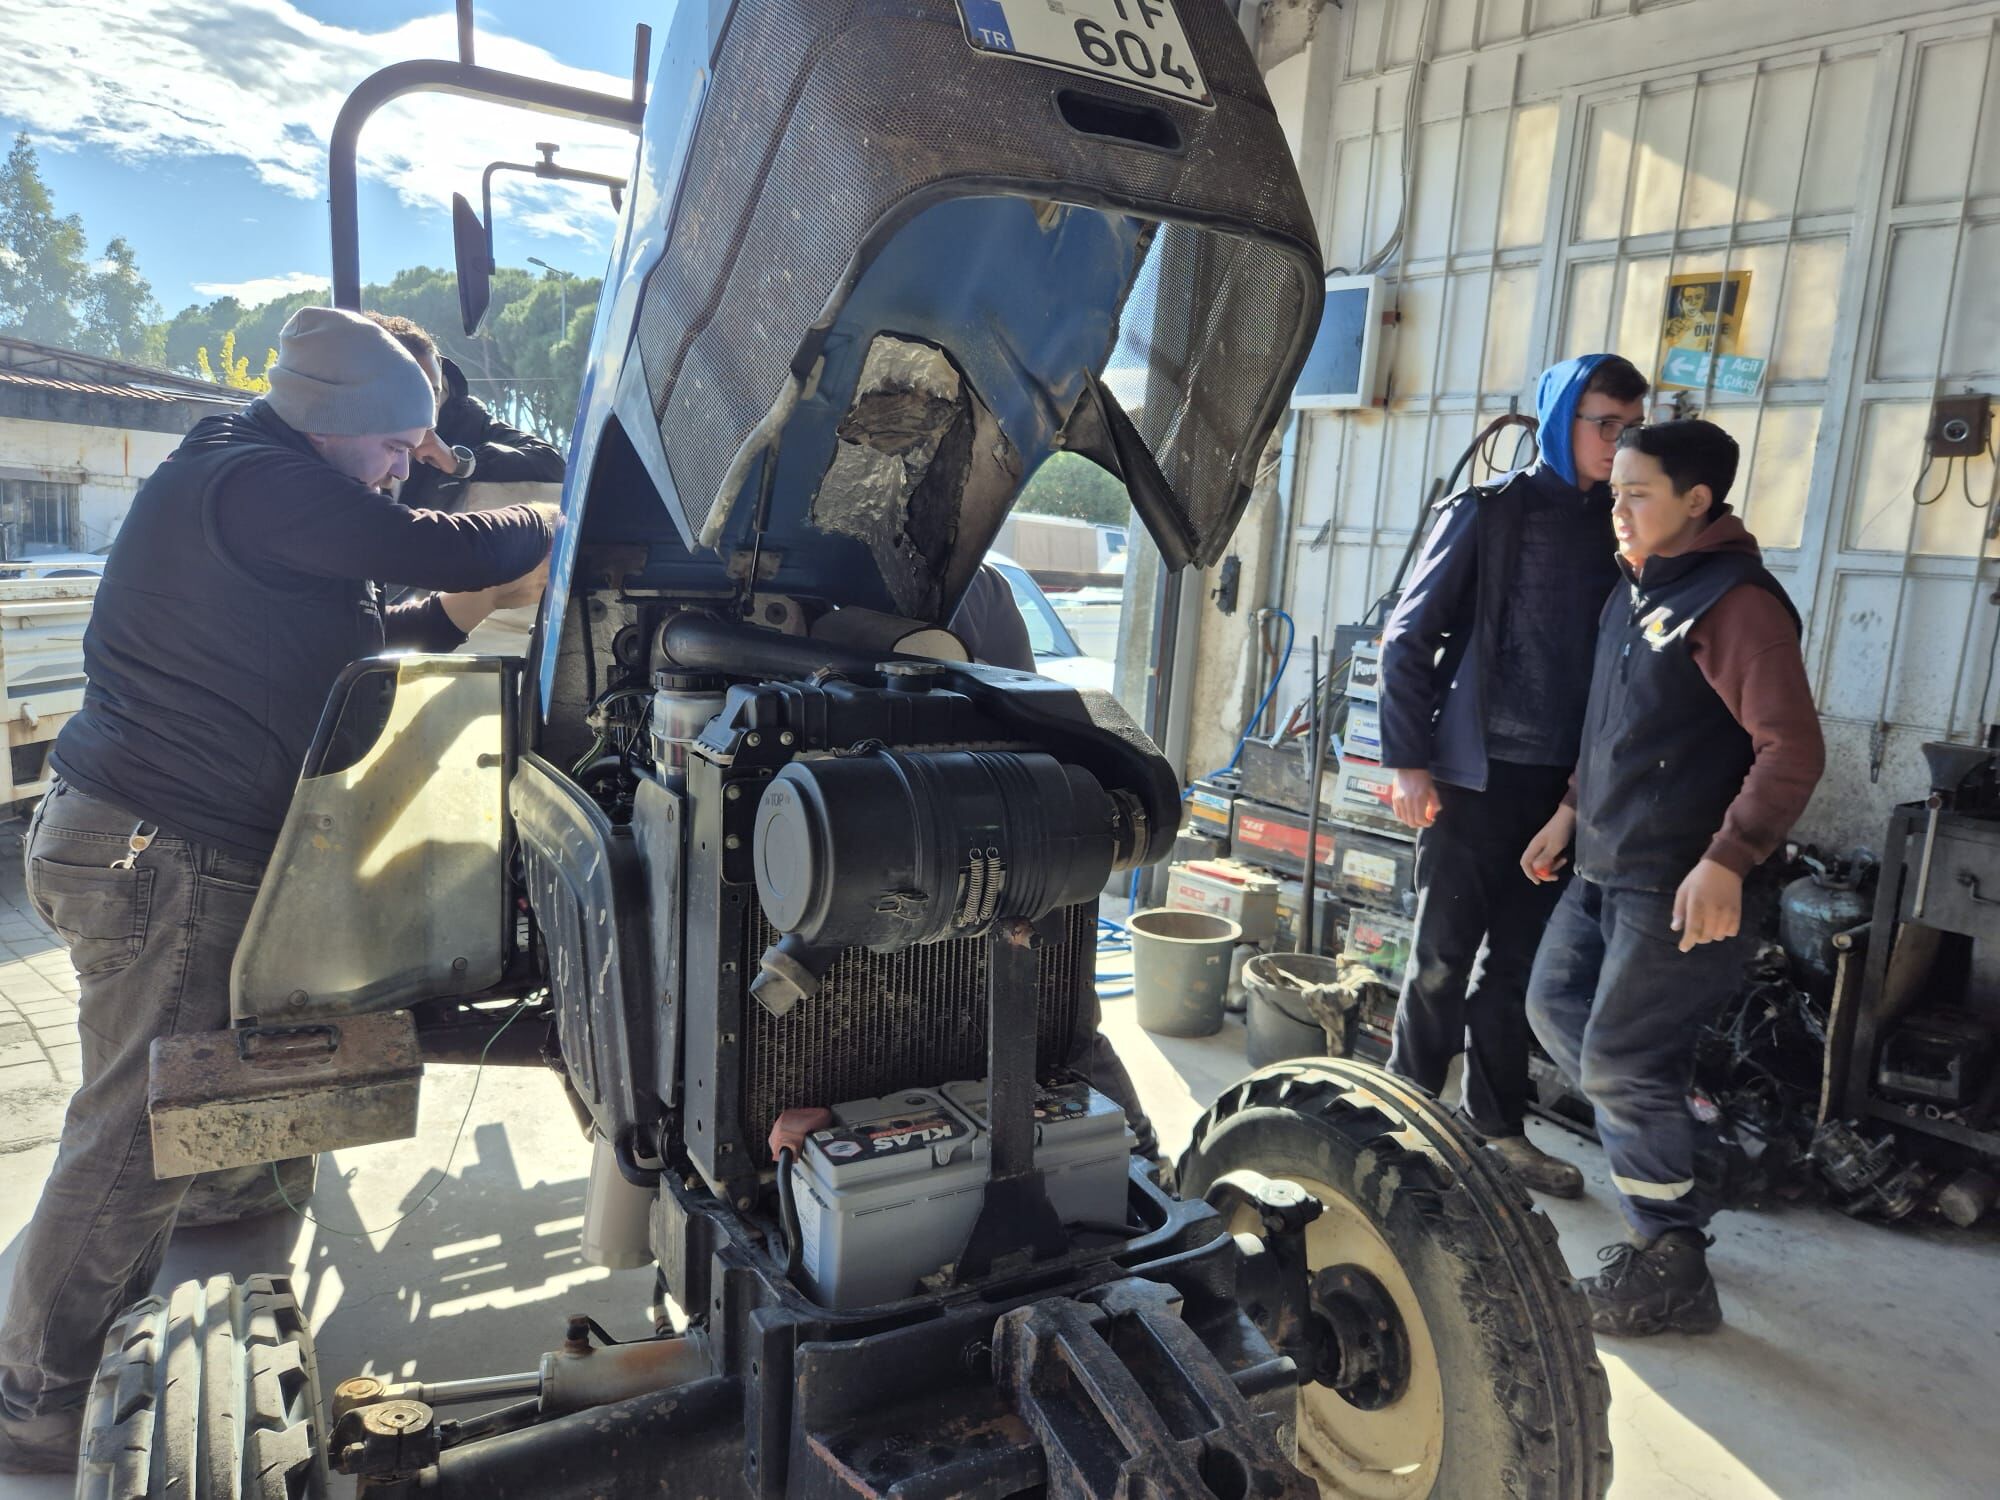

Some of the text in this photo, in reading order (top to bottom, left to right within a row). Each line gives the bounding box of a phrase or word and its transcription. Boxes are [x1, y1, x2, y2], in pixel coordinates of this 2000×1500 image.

[978, 27, 1008, 48] TR
[1074, 19, 1195, 89] 604
[873, 1125, 953, 1150] KLAS
